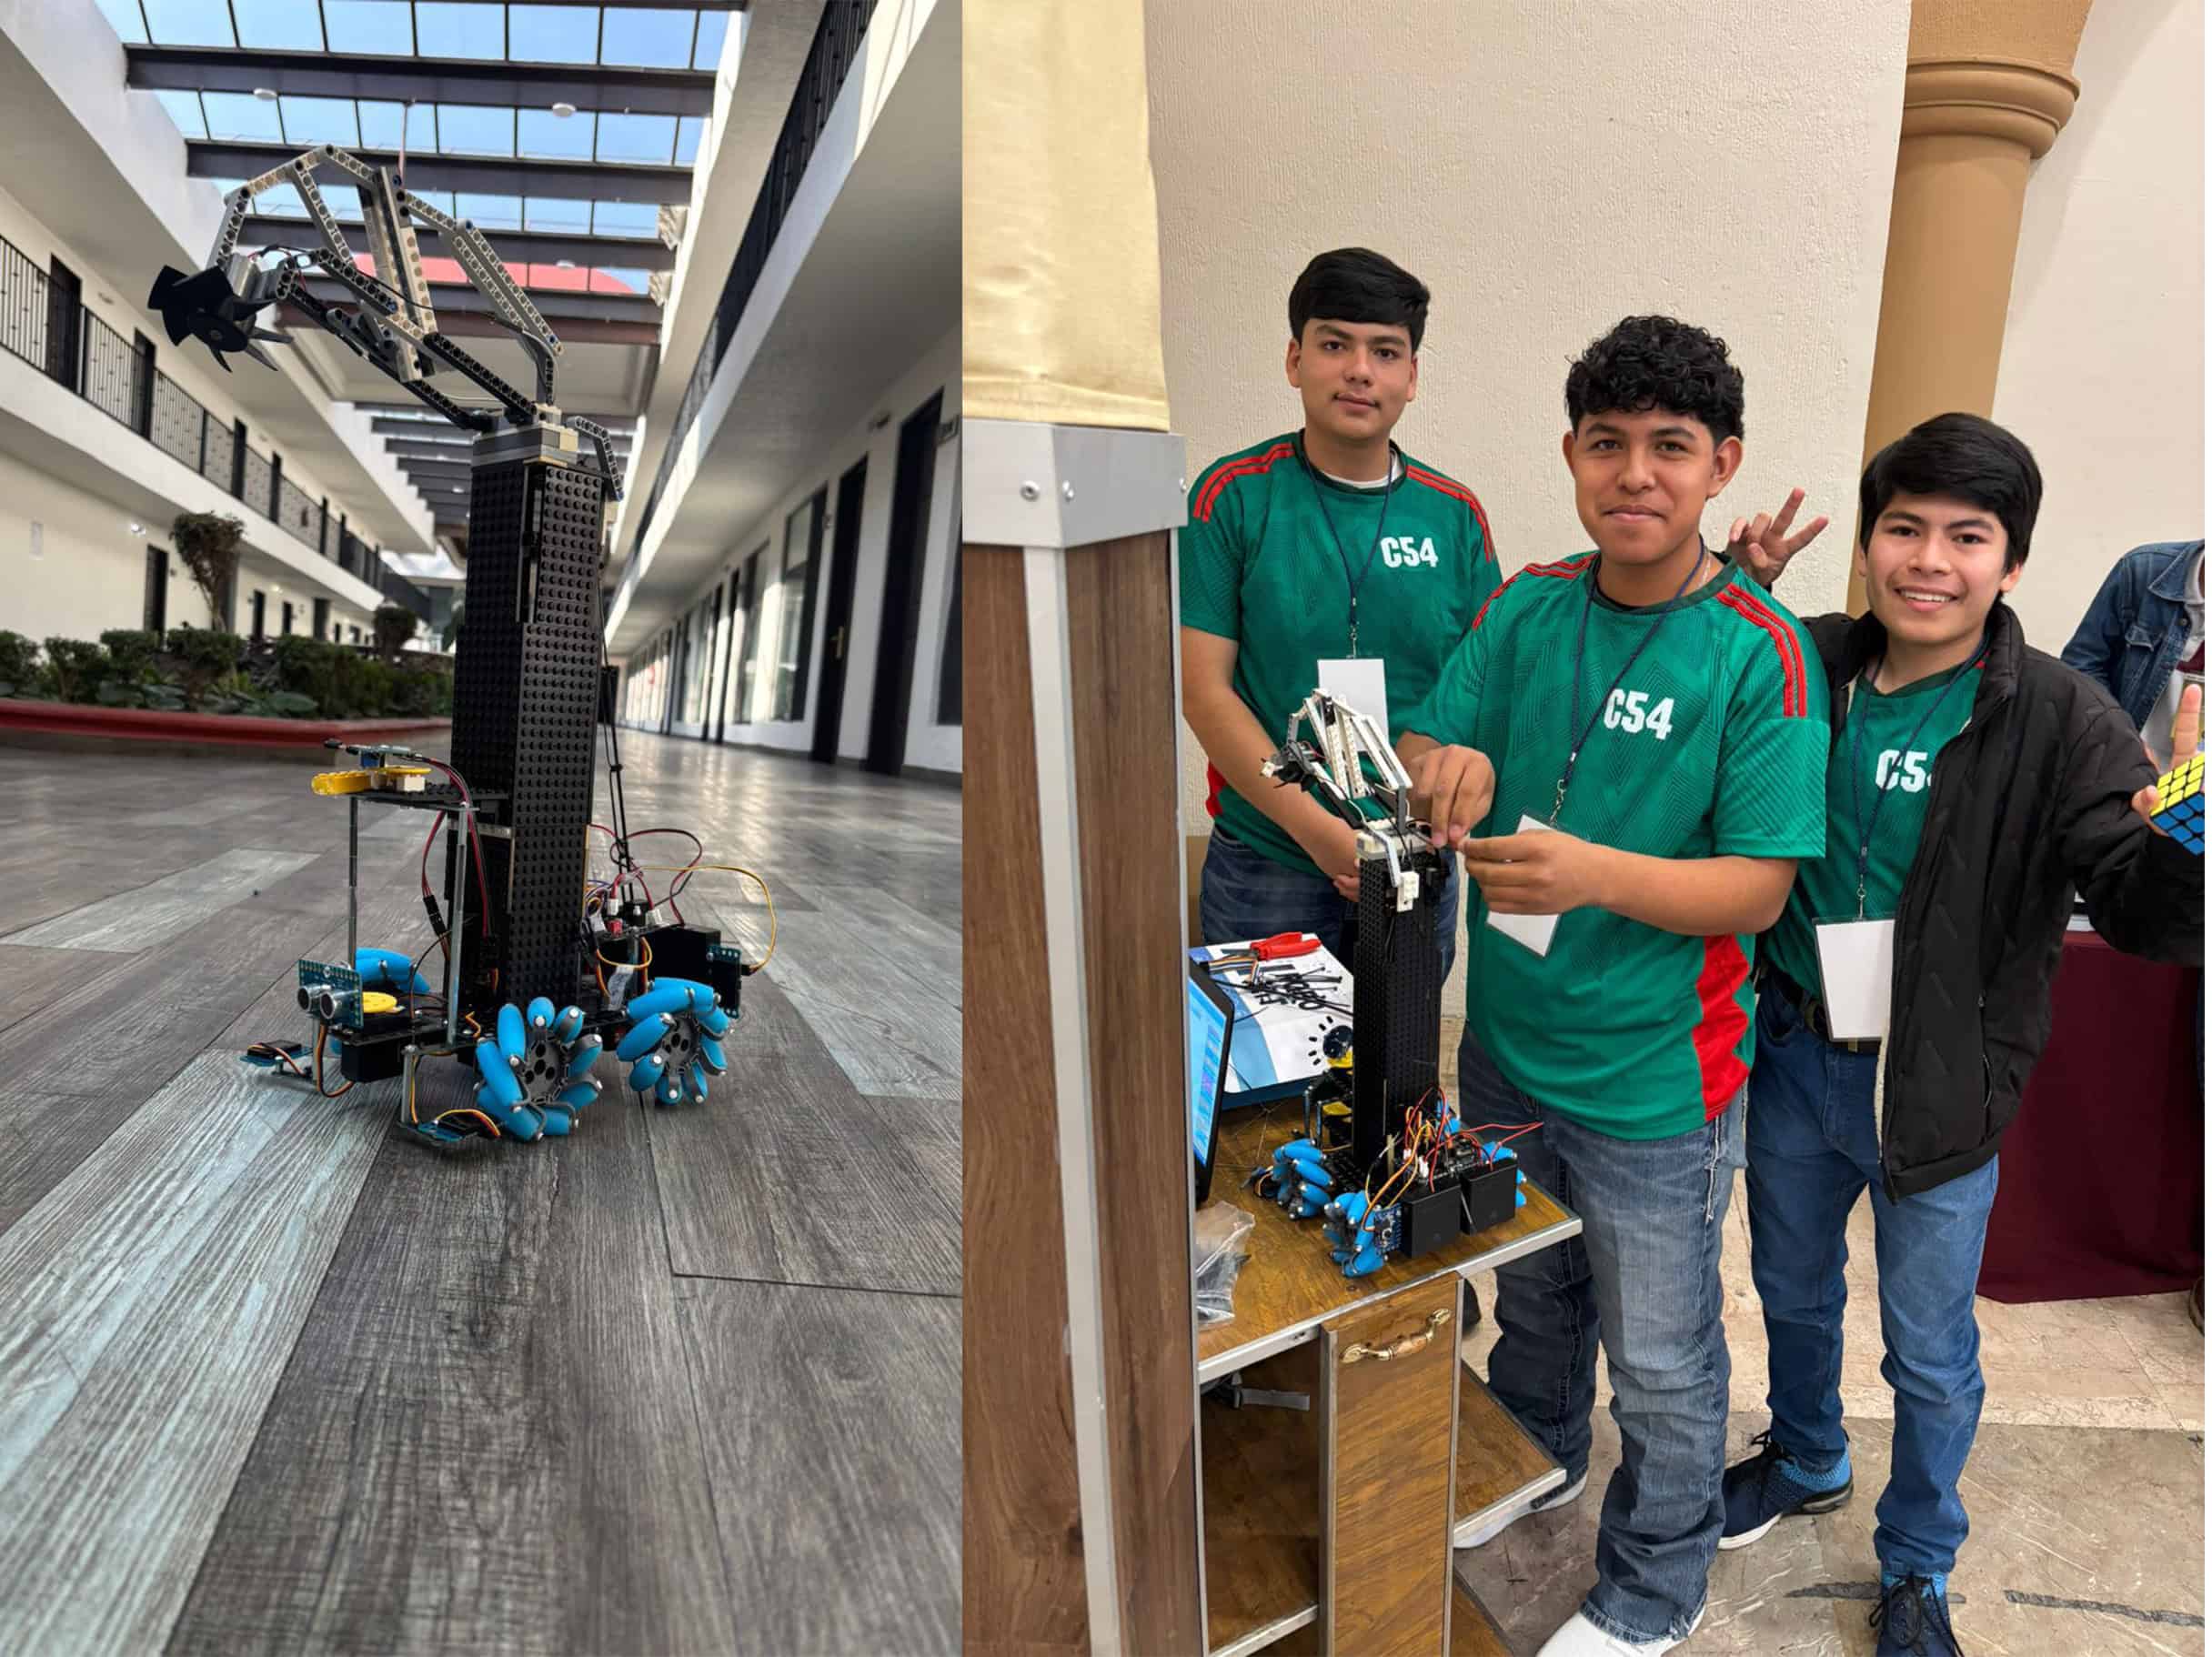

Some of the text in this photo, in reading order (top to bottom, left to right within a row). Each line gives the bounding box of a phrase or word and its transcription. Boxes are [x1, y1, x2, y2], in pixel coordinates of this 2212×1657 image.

[1380, 536, 1439, 568] C54
[1604, 688, 1674, 740] C54
[1875, 748, 1932, 793] C5
